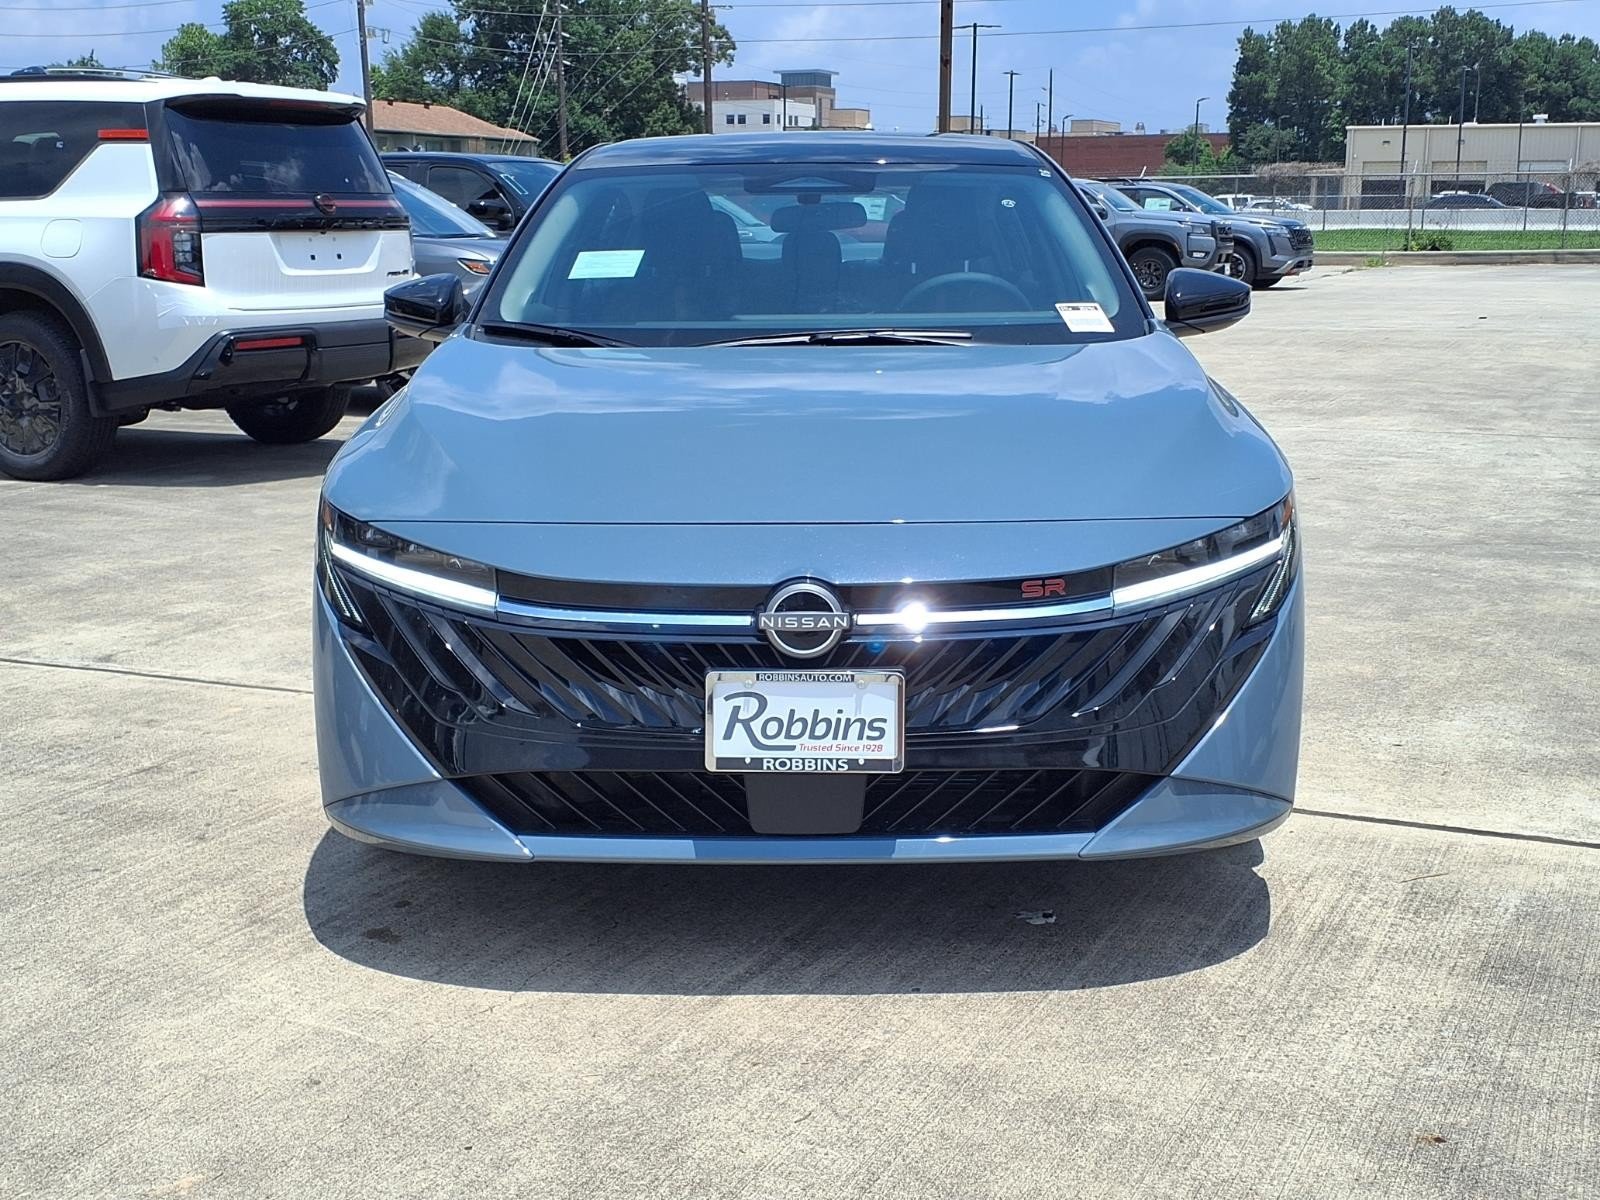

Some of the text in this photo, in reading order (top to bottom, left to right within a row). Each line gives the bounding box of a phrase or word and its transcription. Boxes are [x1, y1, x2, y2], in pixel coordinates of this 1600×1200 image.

[1021, 578, 1066, 598] SR
[761, 616, 847, 628] NISSAN
[758, 673, 852, 682] ROBBINSAUTO.COM
[722, 691, 888, 752] Robbins
[799, 743, 883, 753] Trusted Since 1928
[762, 758, 849, 771] ROBBINS
